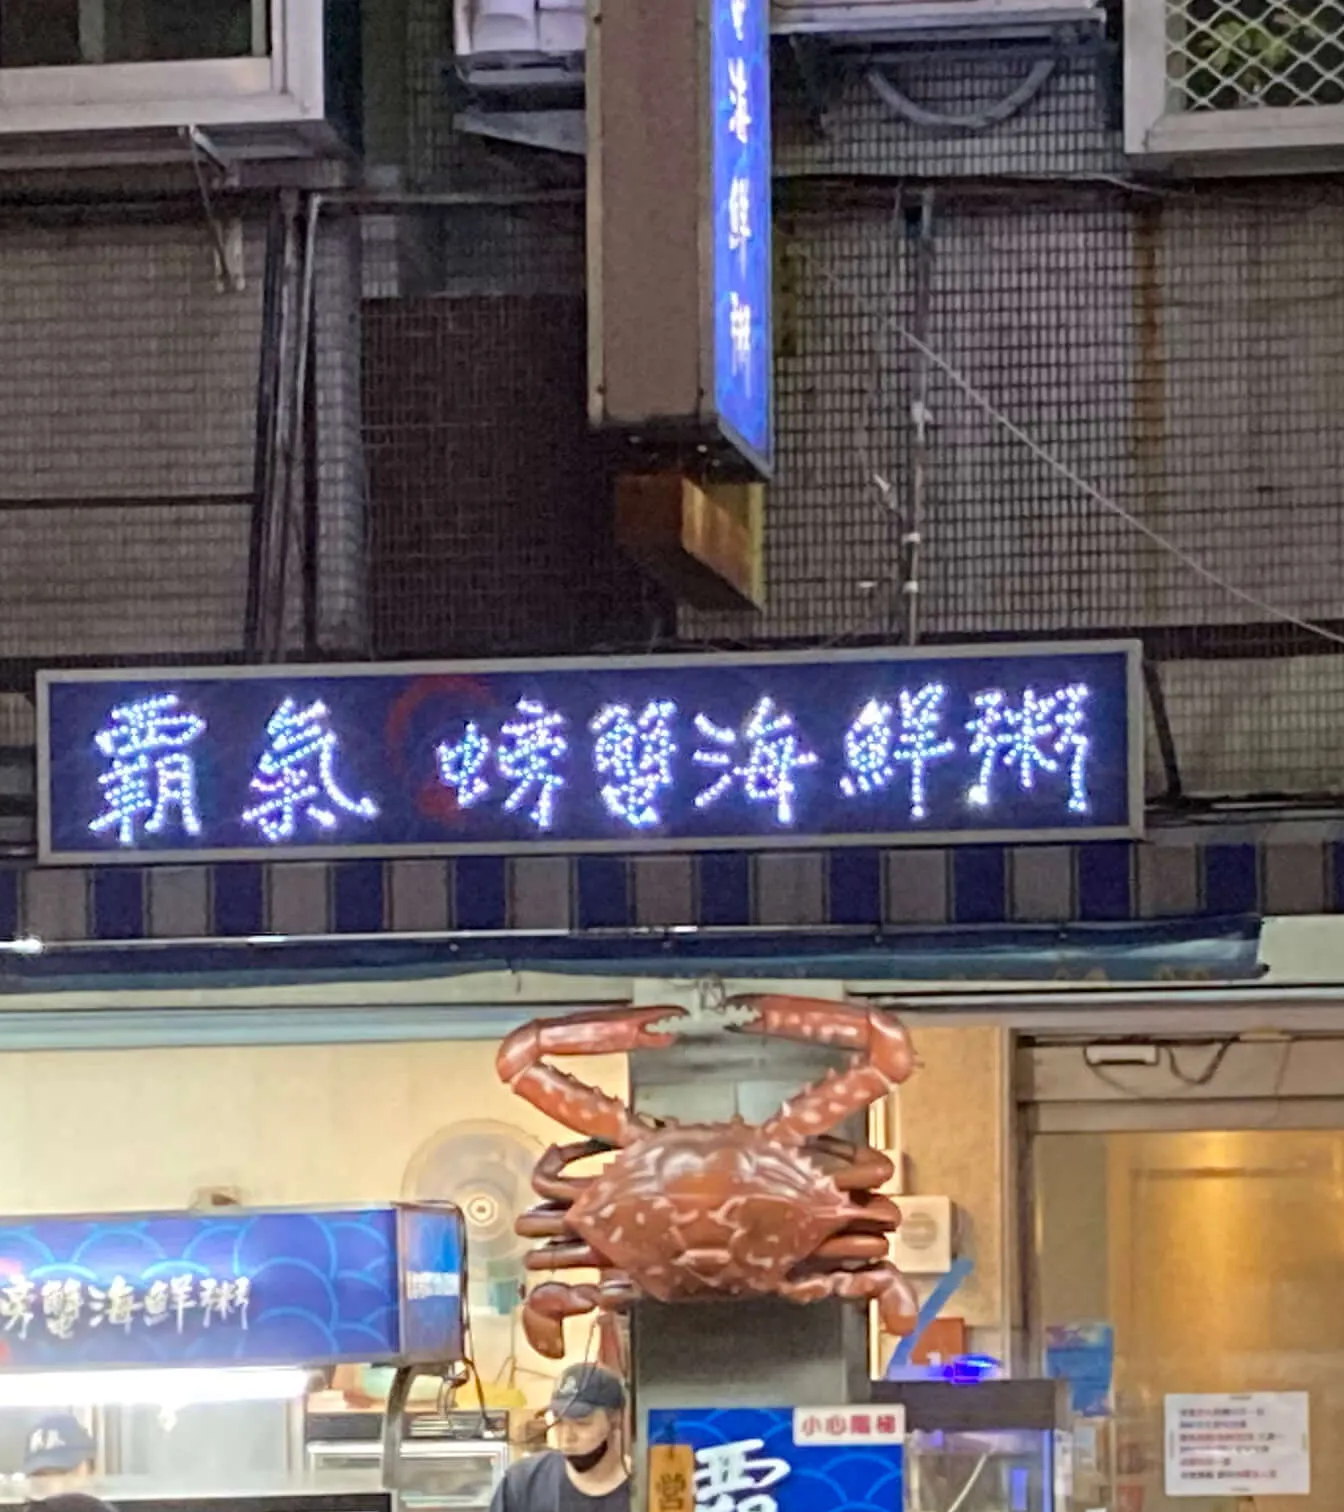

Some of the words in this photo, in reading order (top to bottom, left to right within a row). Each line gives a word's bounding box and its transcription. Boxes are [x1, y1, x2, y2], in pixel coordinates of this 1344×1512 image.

[88, 692, 380, 844] 霸氣
[436, 682, 1094, 830] 螃蟹海鮮粥
